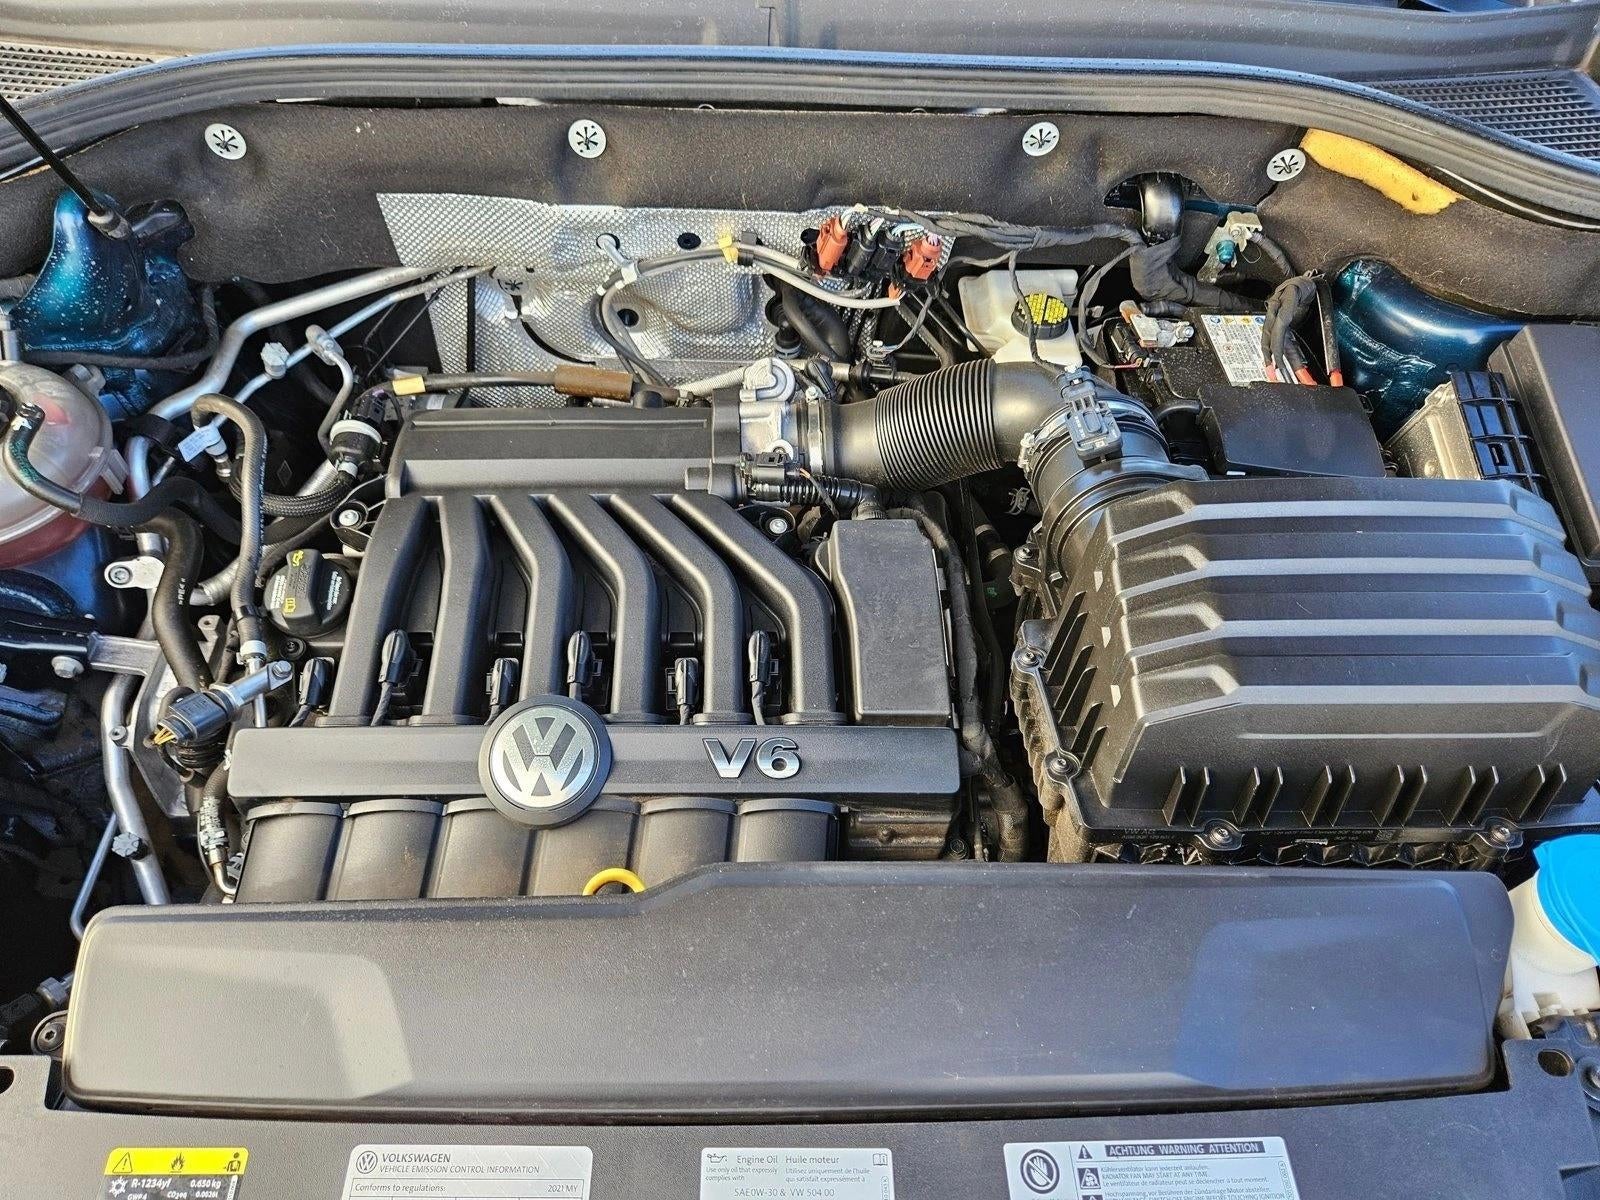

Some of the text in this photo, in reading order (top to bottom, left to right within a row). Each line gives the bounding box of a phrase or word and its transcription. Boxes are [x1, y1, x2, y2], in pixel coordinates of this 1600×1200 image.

[702, 737, 802, 779] V6
[1109, 1142, 1259, 1156] ACHTUNG WARNING ATTENTION
[382, 1153, 451, 1163] VOLKSWAGEN
[737, 1155, 778, 1166] Engine Oil
[785, 1155, 840, 1164] Huile moteur
[380, 1165, 540, 1174] VEHICLE EMISSION CONTROL INFORMATION
[717, 1167, 730, 1175] only
[1102, 1172, 1129, 1180] RADIATOR
[1142, 1171, 1155, 1179] MAY
[1156, 1171, 1173, 1179] START
[131, 1177, 172, 1190] R-1234yf
[211, 1178, 222, 1190] kg
[355, 1183, 447, 1195] Conforms to regulations:
[547, 1184, 578, 1193] 2021 MY
[790, 1188, 804, 1197] VW
[806, 1188, 822, 1197] 504
[824, 1188, 835, 1197] 00
